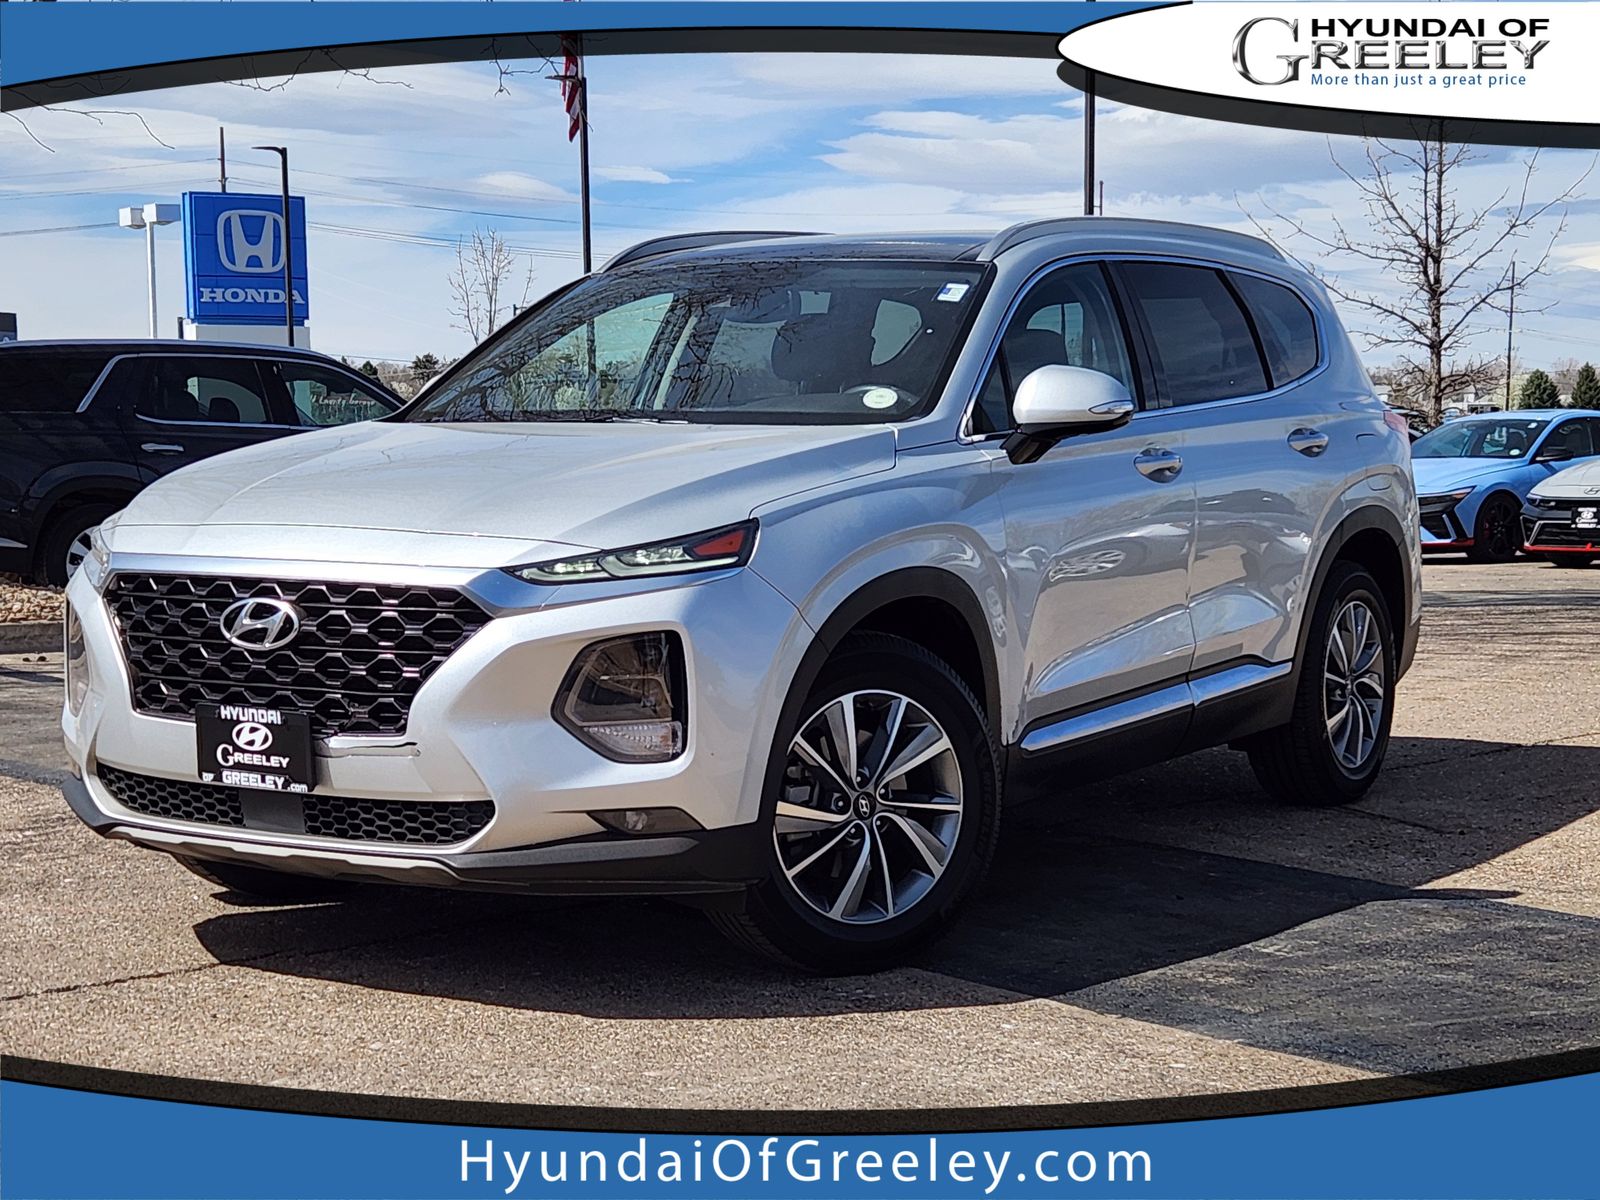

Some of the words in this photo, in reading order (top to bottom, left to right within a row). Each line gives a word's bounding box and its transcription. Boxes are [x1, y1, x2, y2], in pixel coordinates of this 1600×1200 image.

[200, 287, 305, 304] HONDA
[220, 704, 282, 725] HYUNDAI
[216, 743, 290, 768] GREELEY
